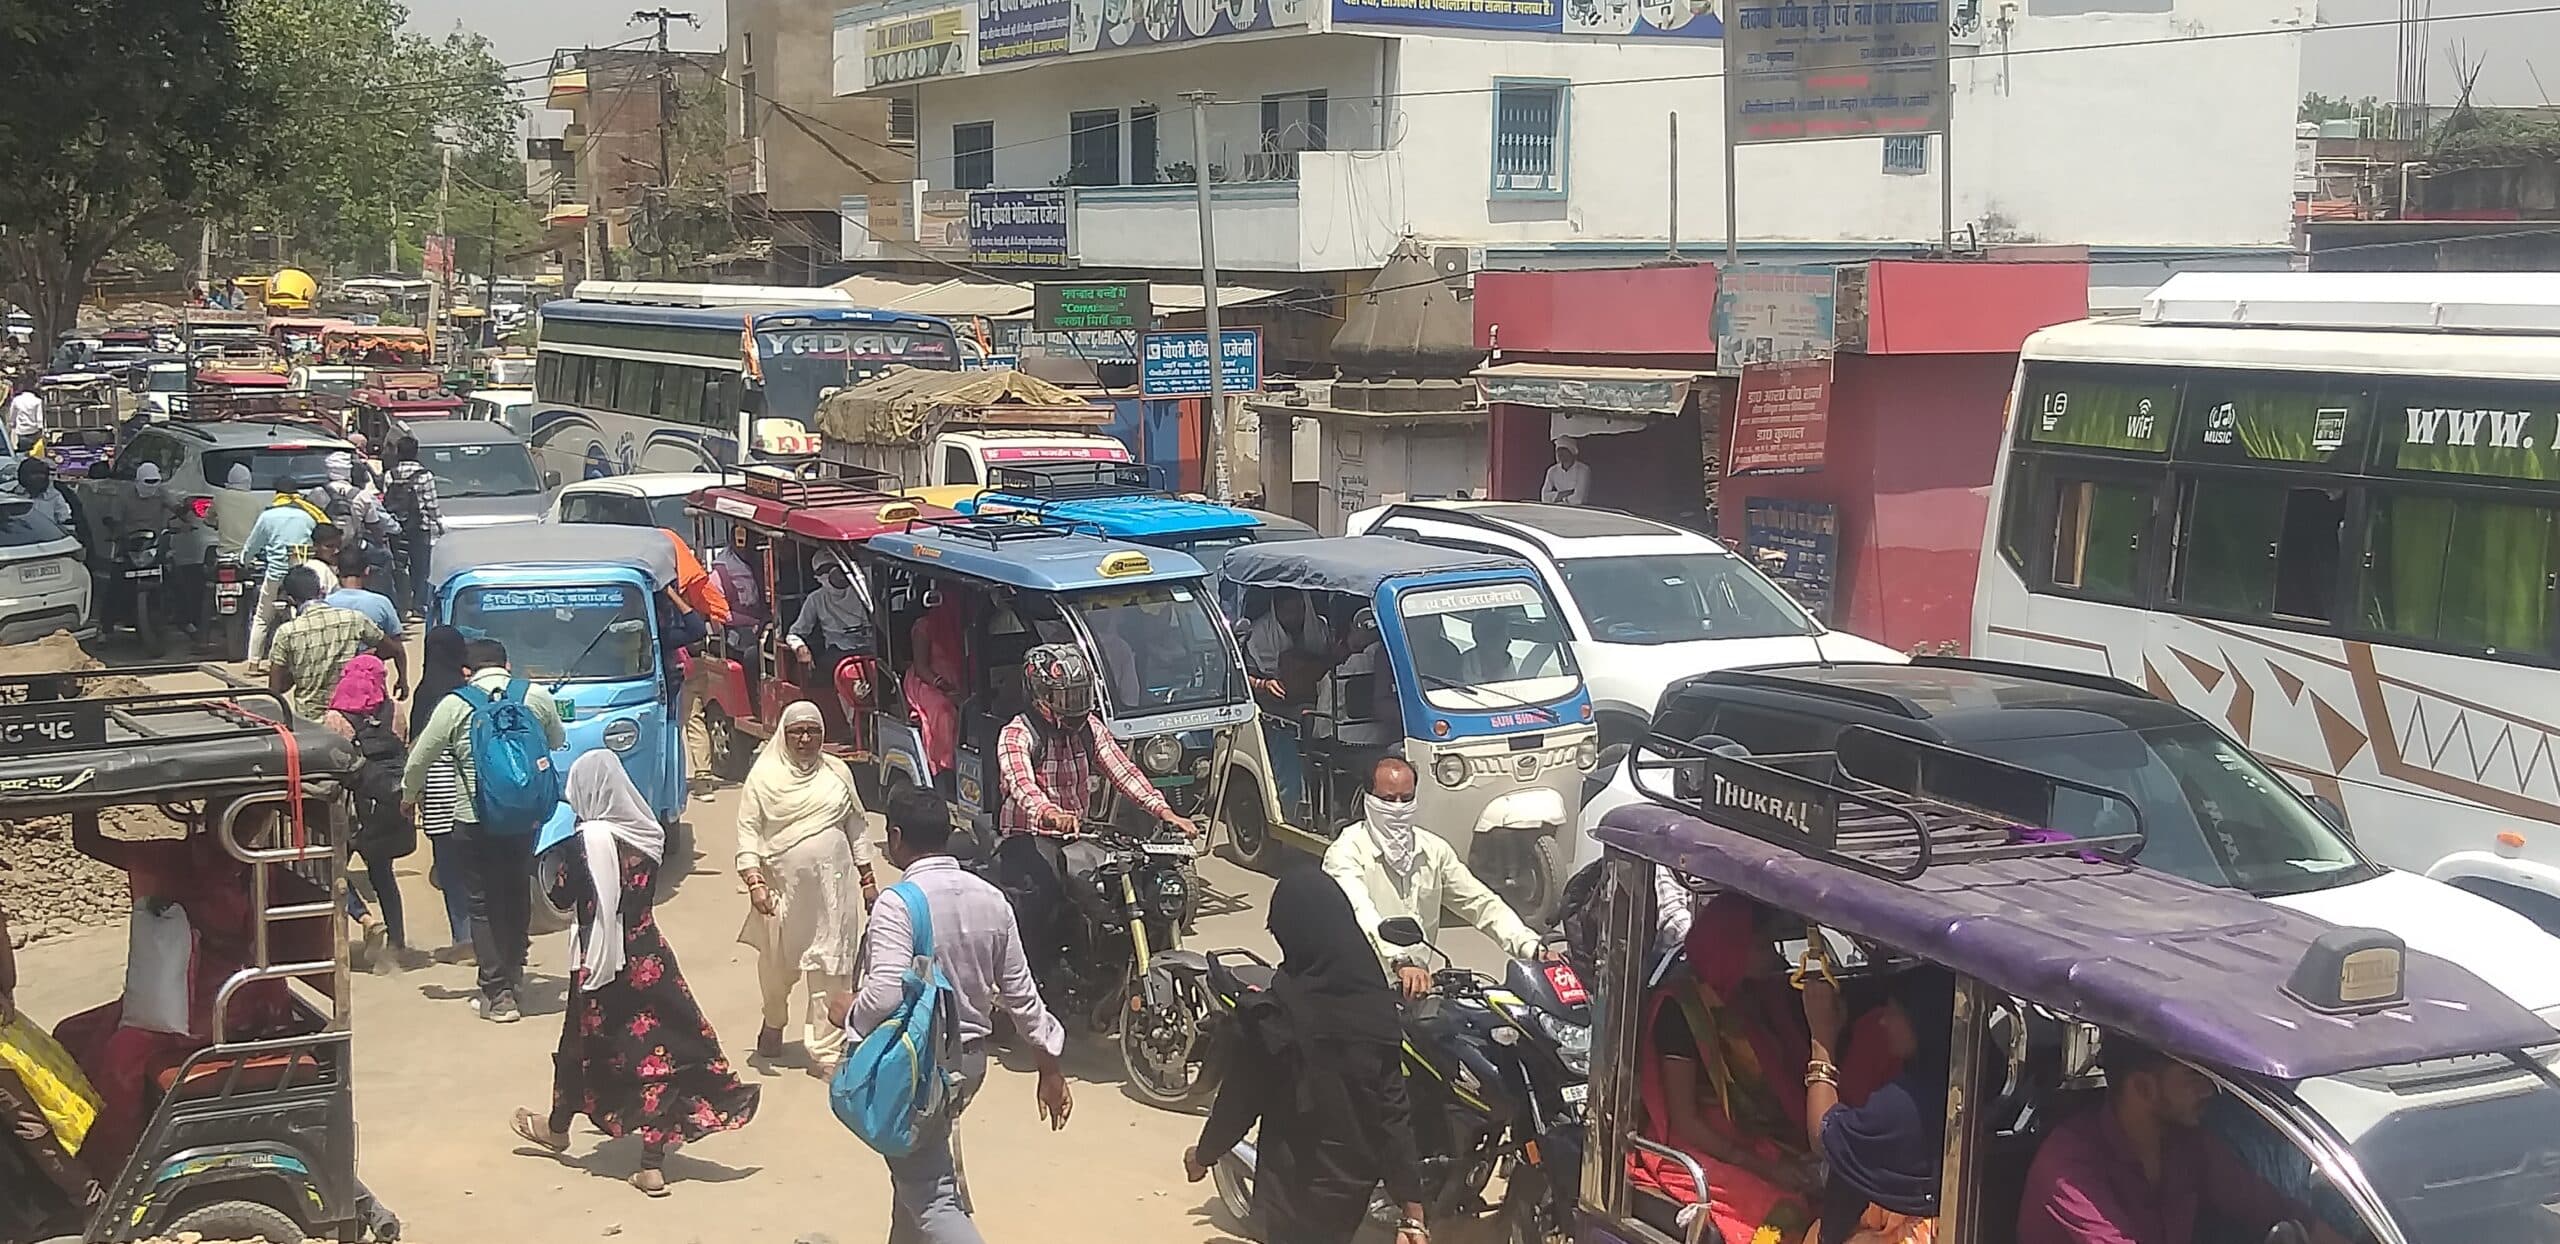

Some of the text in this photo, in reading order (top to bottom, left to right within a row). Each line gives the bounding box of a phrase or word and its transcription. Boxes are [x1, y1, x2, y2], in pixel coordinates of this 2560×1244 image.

[764, 332, 909, 355] YADAV
[2127, 415, 2154, 440] WiFi
[2204, 430, 2233, 444] MUSIC
[1713, 773, 1810, 834] THUKRAL
